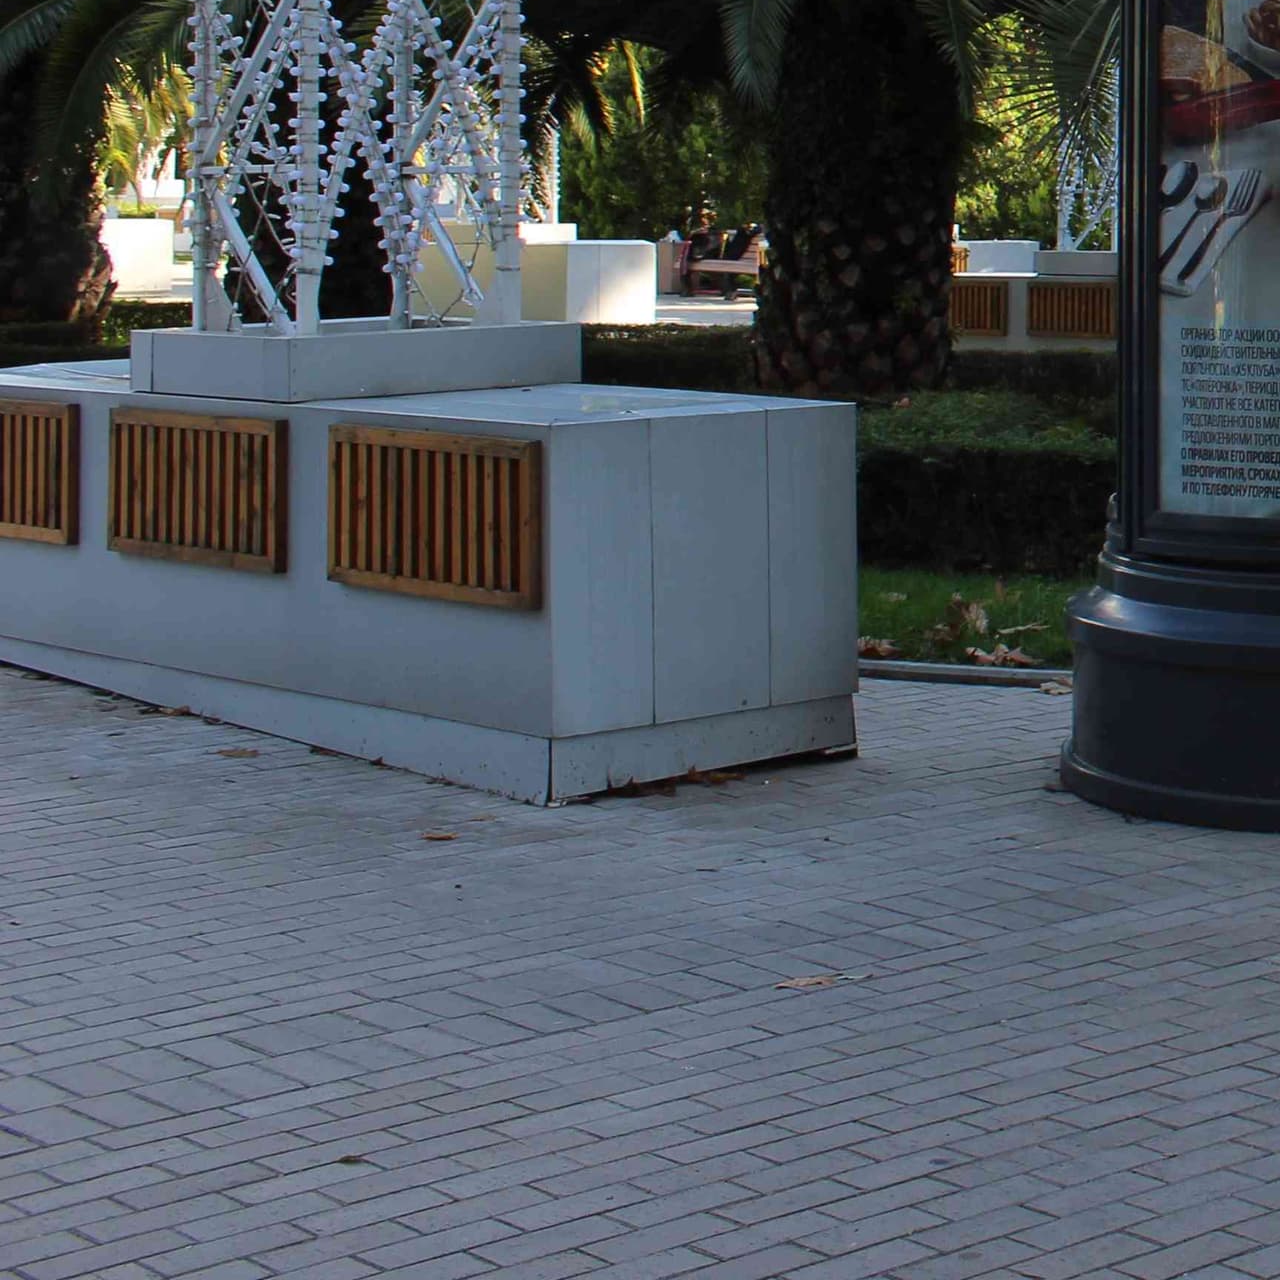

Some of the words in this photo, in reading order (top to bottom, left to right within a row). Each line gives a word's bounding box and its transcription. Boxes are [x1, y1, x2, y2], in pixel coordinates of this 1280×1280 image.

[1181, 328, 1233, 341] ОРГАНИЗТОР
[1234, 329, 1265, 344] АКЦИИ
[1238, 398, 1253, 411] ВСЕ
[1230, 450, 1245, 463] ЕГО
[1201, 482, 1247, 497] ТЕЛЕФОНУ
